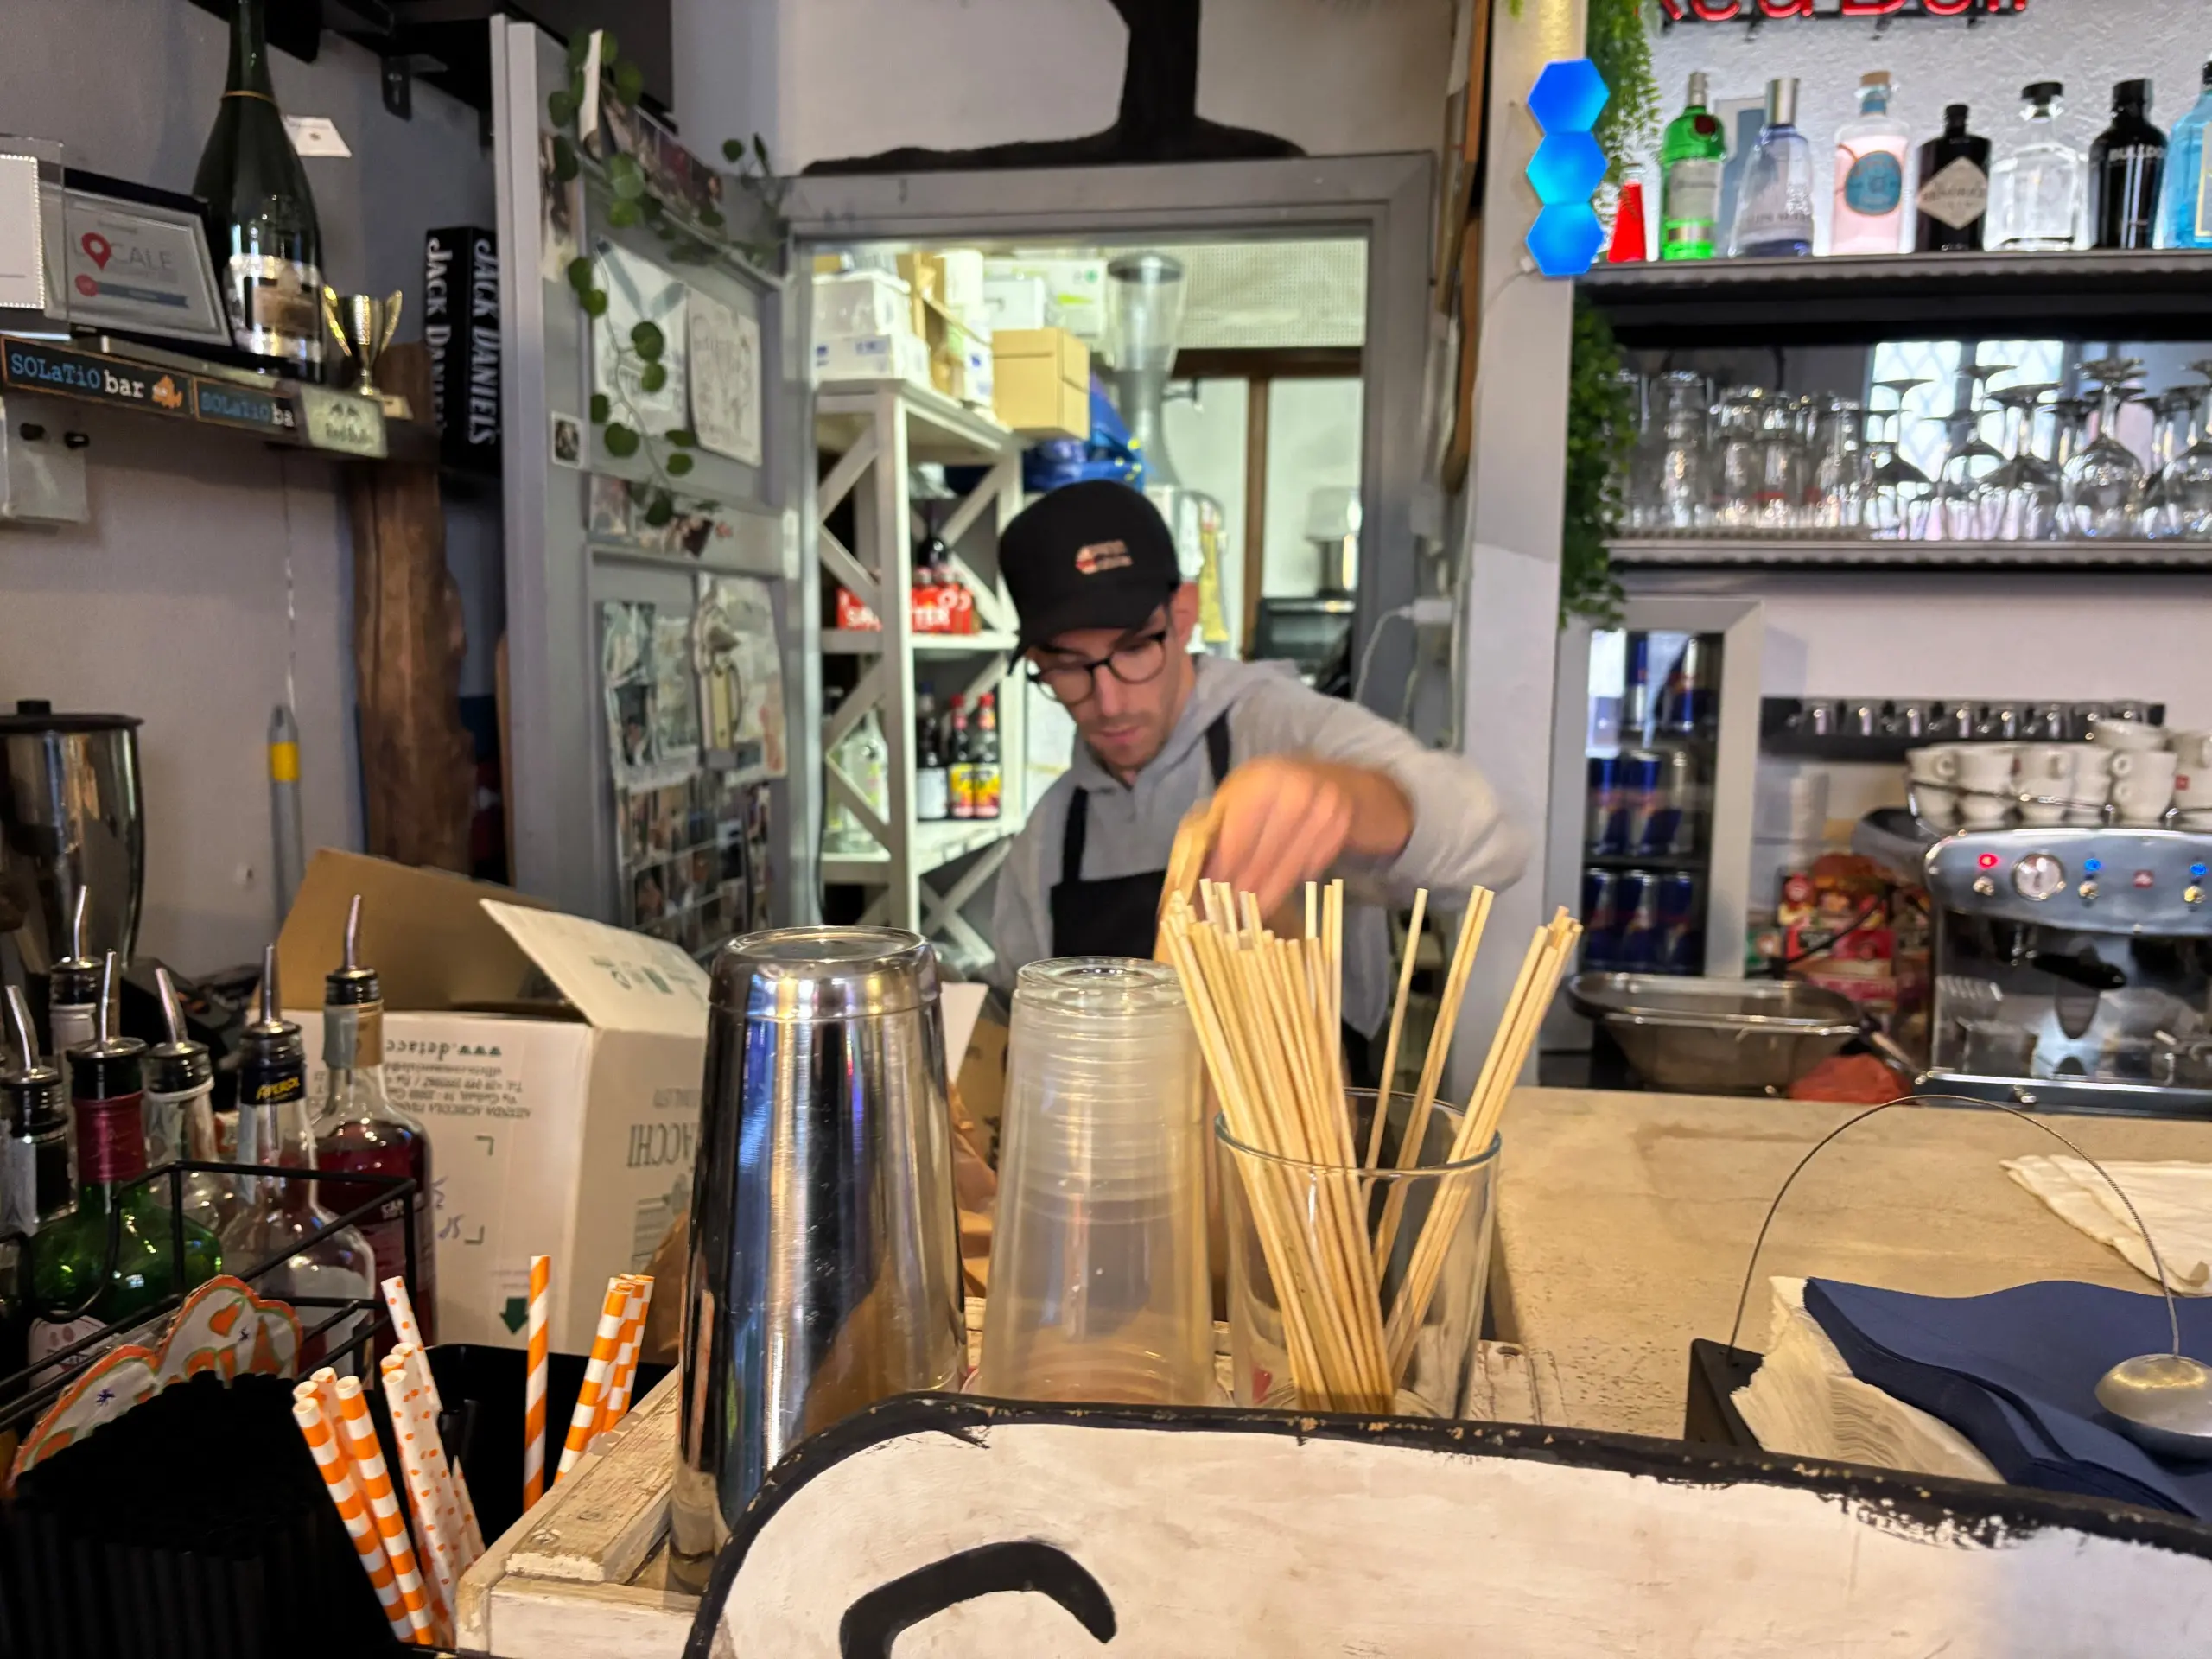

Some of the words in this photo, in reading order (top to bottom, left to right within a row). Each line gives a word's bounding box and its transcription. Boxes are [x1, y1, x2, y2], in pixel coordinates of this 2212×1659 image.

[426, 237, 453, 316] JACK
[474, 238, 499, 318] JACK
[104, 369, 145, 398] bar
[270, 402, 295, 428] ba
